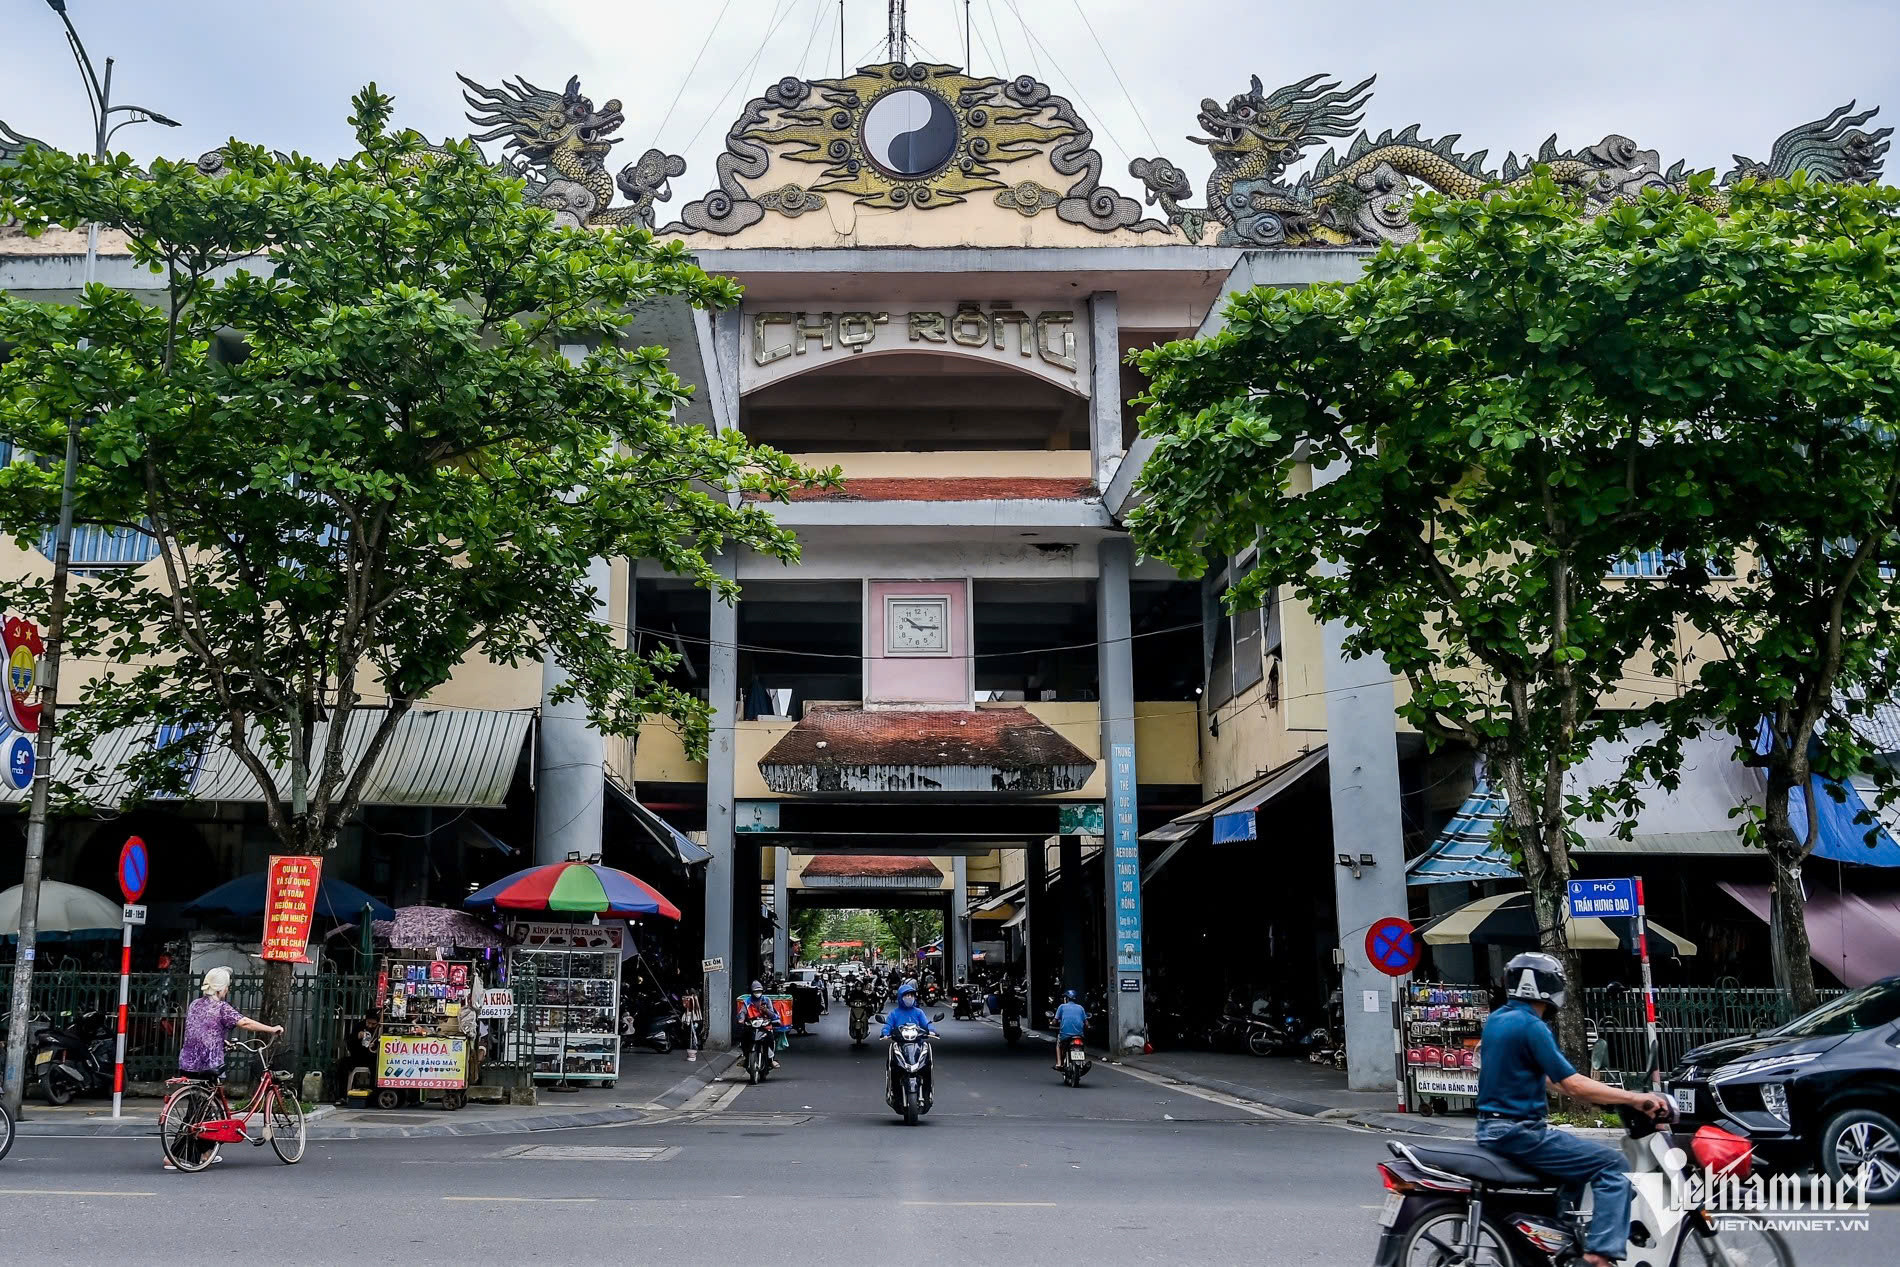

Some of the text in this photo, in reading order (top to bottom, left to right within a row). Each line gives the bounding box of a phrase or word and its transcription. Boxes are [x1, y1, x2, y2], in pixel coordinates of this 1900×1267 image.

[1593, 881, 1616, 892] PHỐ
[1574, 896, 1629, 912] TRẦN HƯNG ĐẠO
[490, 989, 512, 1006] KHÓA
[480, 1008, 511, 1016] 6662173
[384, 1038, 448, 1055] SỬA KHÓA
[400, 1079, 416, 1087] 094
[1467, 1083, 1479, 1093] MÁ
